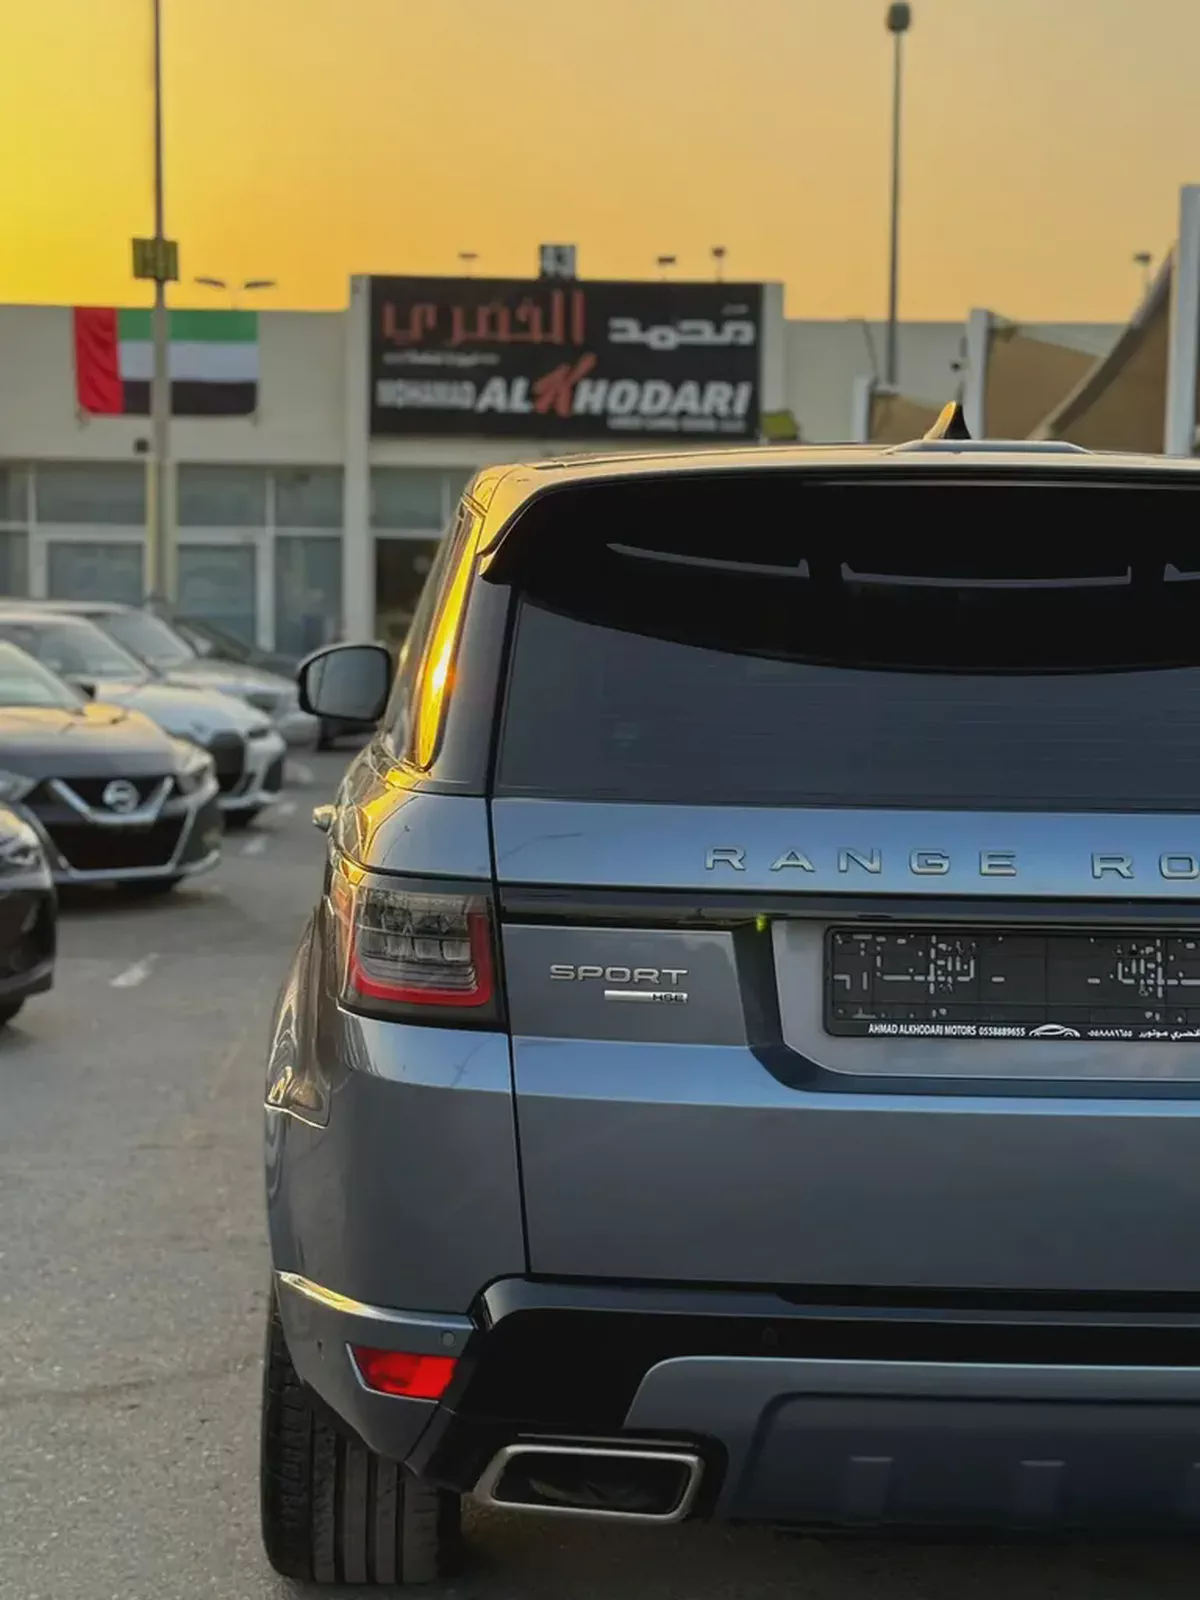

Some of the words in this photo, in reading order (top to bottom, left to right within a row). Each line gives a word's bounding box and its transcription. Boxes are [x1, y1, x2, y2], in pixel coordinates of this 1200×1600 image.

[608, 316, 755, 350] محمد
[705, 845, 1019, 877] RANGE
[1091, 851, 1200, 880] RO
[549, 963, 689, 985] SPORT
[868, 1023, 898, 1035] AHMAD
[898, 1024, 943, 1036] ALKHODARI
[944, 1025, 977, 1037] MOTORS
